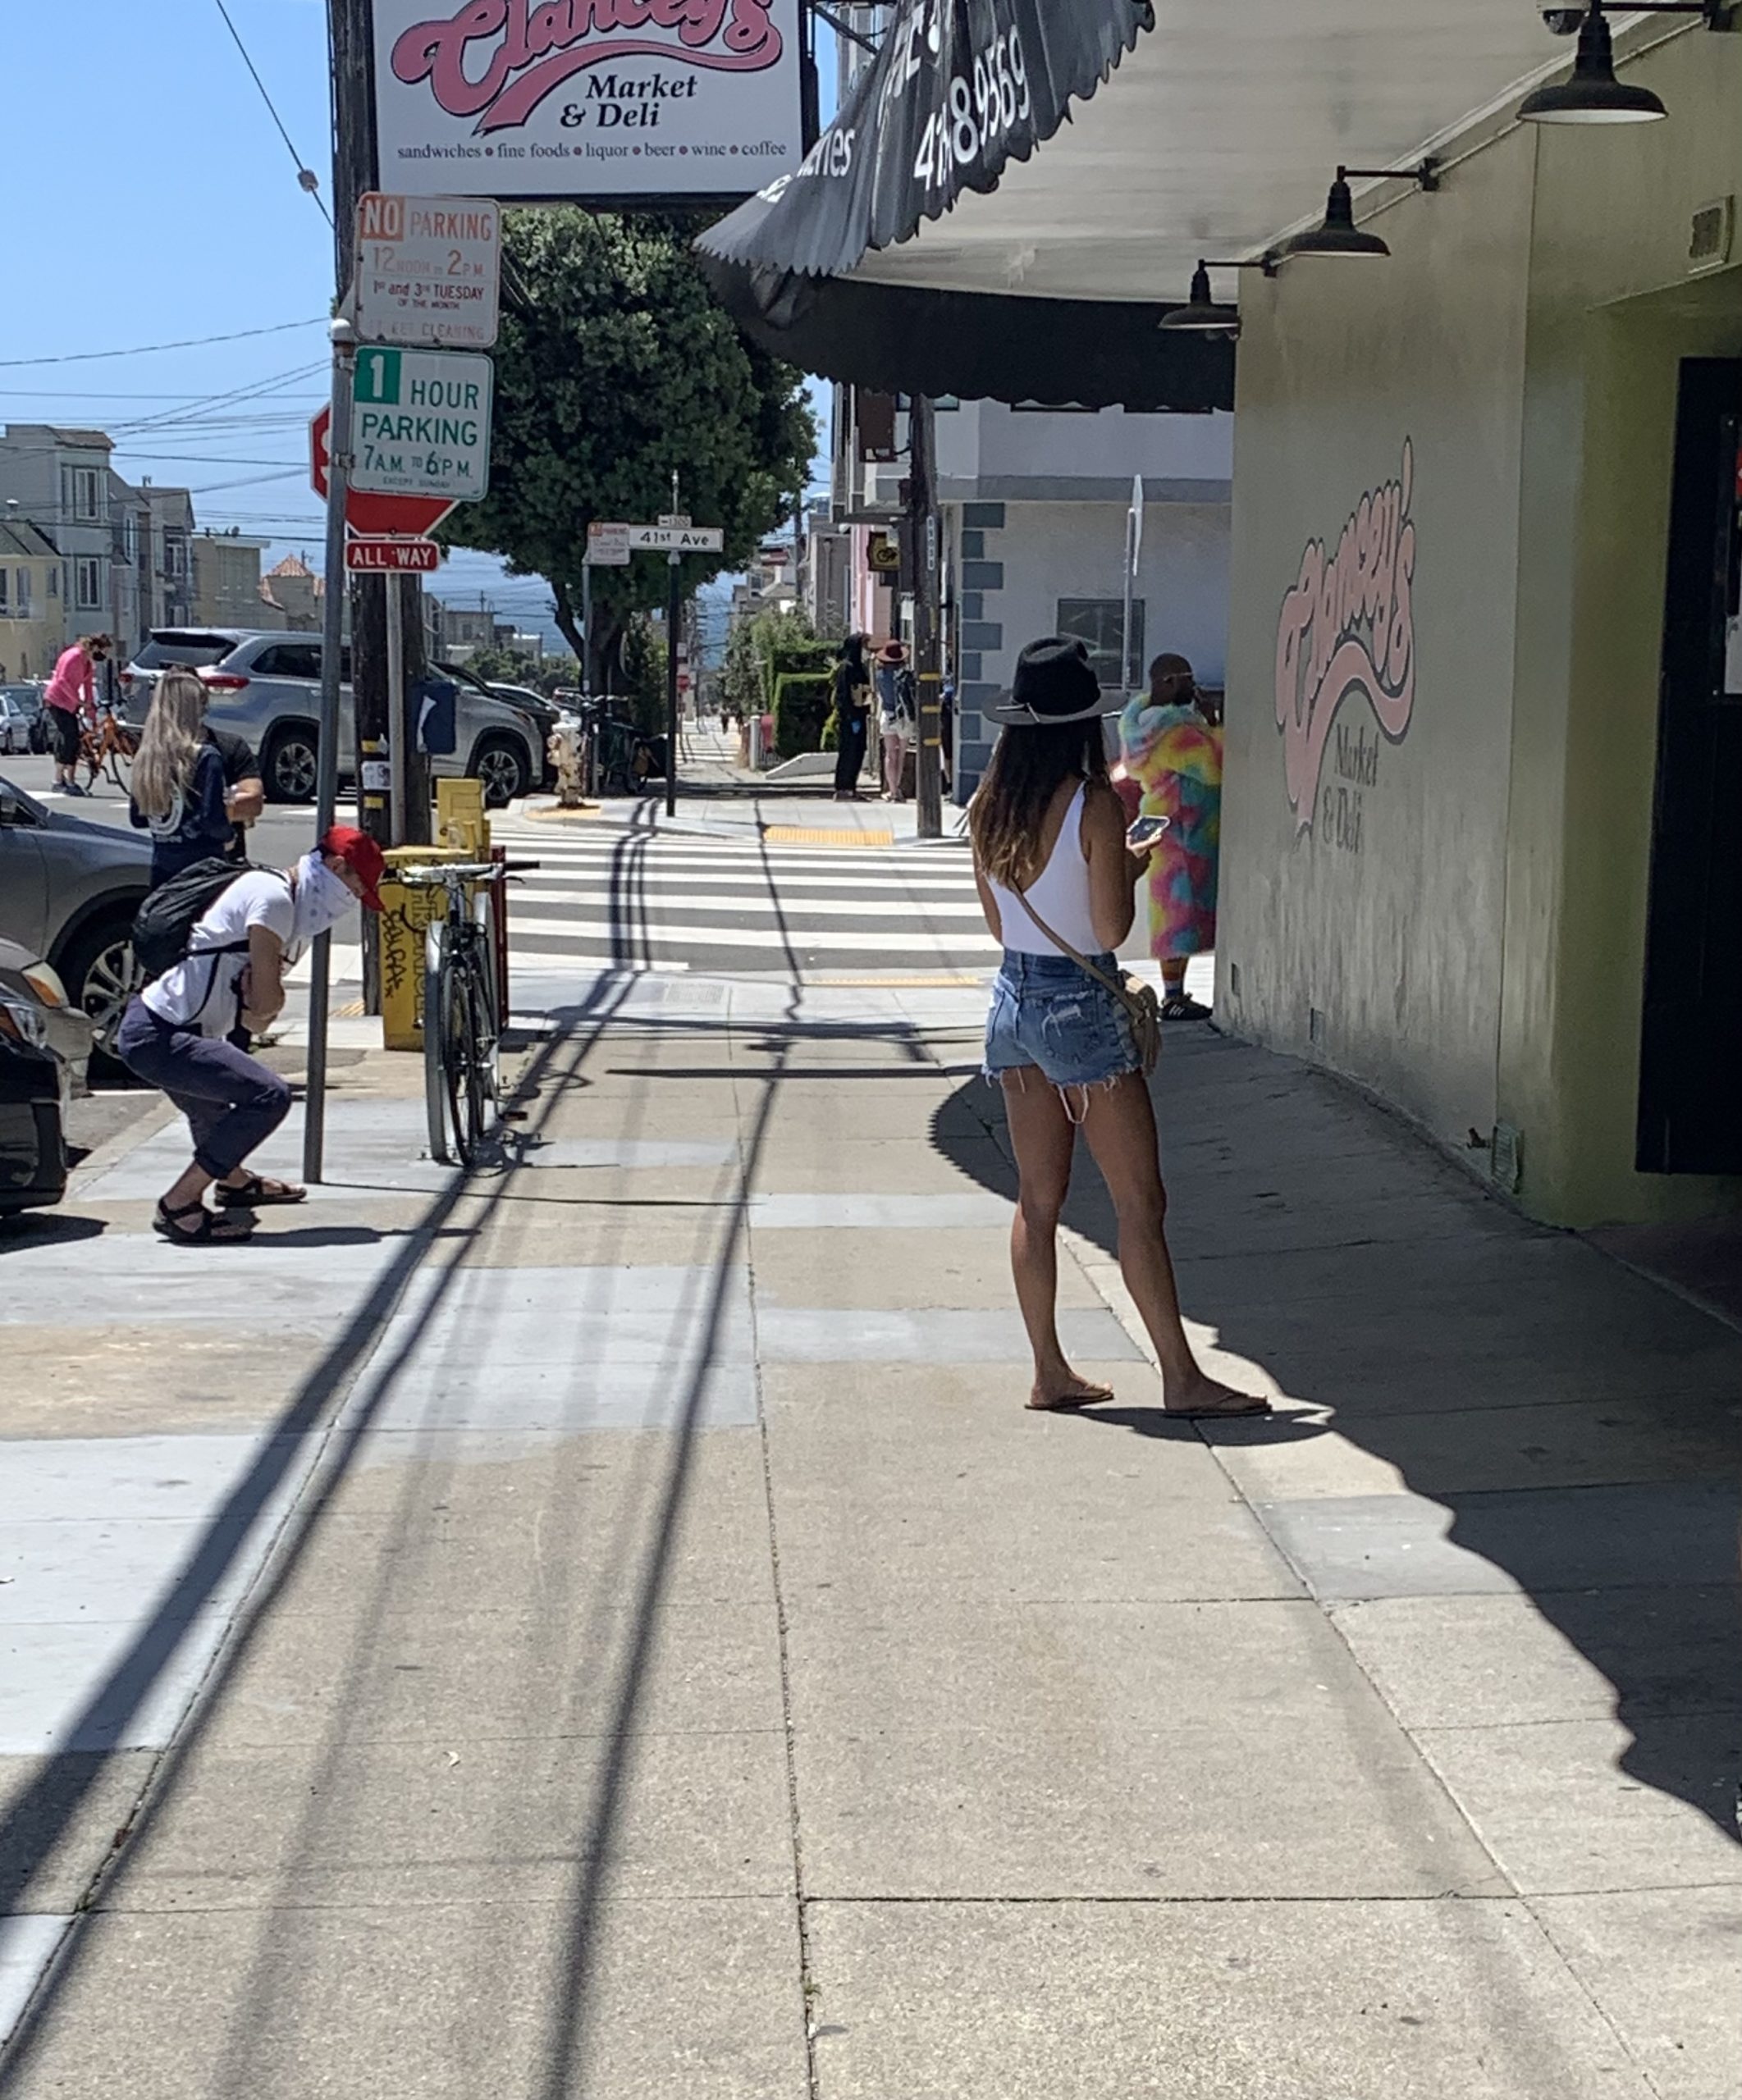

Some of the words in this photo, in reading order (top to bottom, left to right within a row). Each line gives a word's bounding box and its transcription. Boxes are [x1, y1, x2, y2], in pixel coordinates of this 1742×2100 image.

[391, 0, 776, 116] Clanceys
[585, 75, 697, 99] Market
[560, 103, 586, 127] &
[596, 102, 660, 127] Deli
[398, 143, 482, 158] sandwiches
[497, 143, 525, 158] fine
[530, 143, 569, 158] foods
[586, 142, 629, 161] liquor
[644, 142, 675, 157] beer
[692, 143, 726, 156] wine
[741, 141, 787, 156] coffee
[363, 199, 400, 236] NO
[410, 211, 492, 242] PARKING
[388, 282, 409, 297] and
[433, 284, 484, 301] TUESDAY
[431, 301, 460, 310] MONTH
[371, 354, 385, 399] 1
[410, 379, 479, 410] HOUR
[361, 413, 478, 447] PARKING
[411, 456, 423, 468] TO
[382, 476, 413, 487] EXCEPT
[640, 532, 671, 545] 41st
[680, 533, 709, 546] Ave
[353, 547, 387, 566] ALL
[396, 546, 433, 567] WAY
[1334, 723, 1379, 788] Market
[1336, 787, 1362, 854] Deli
